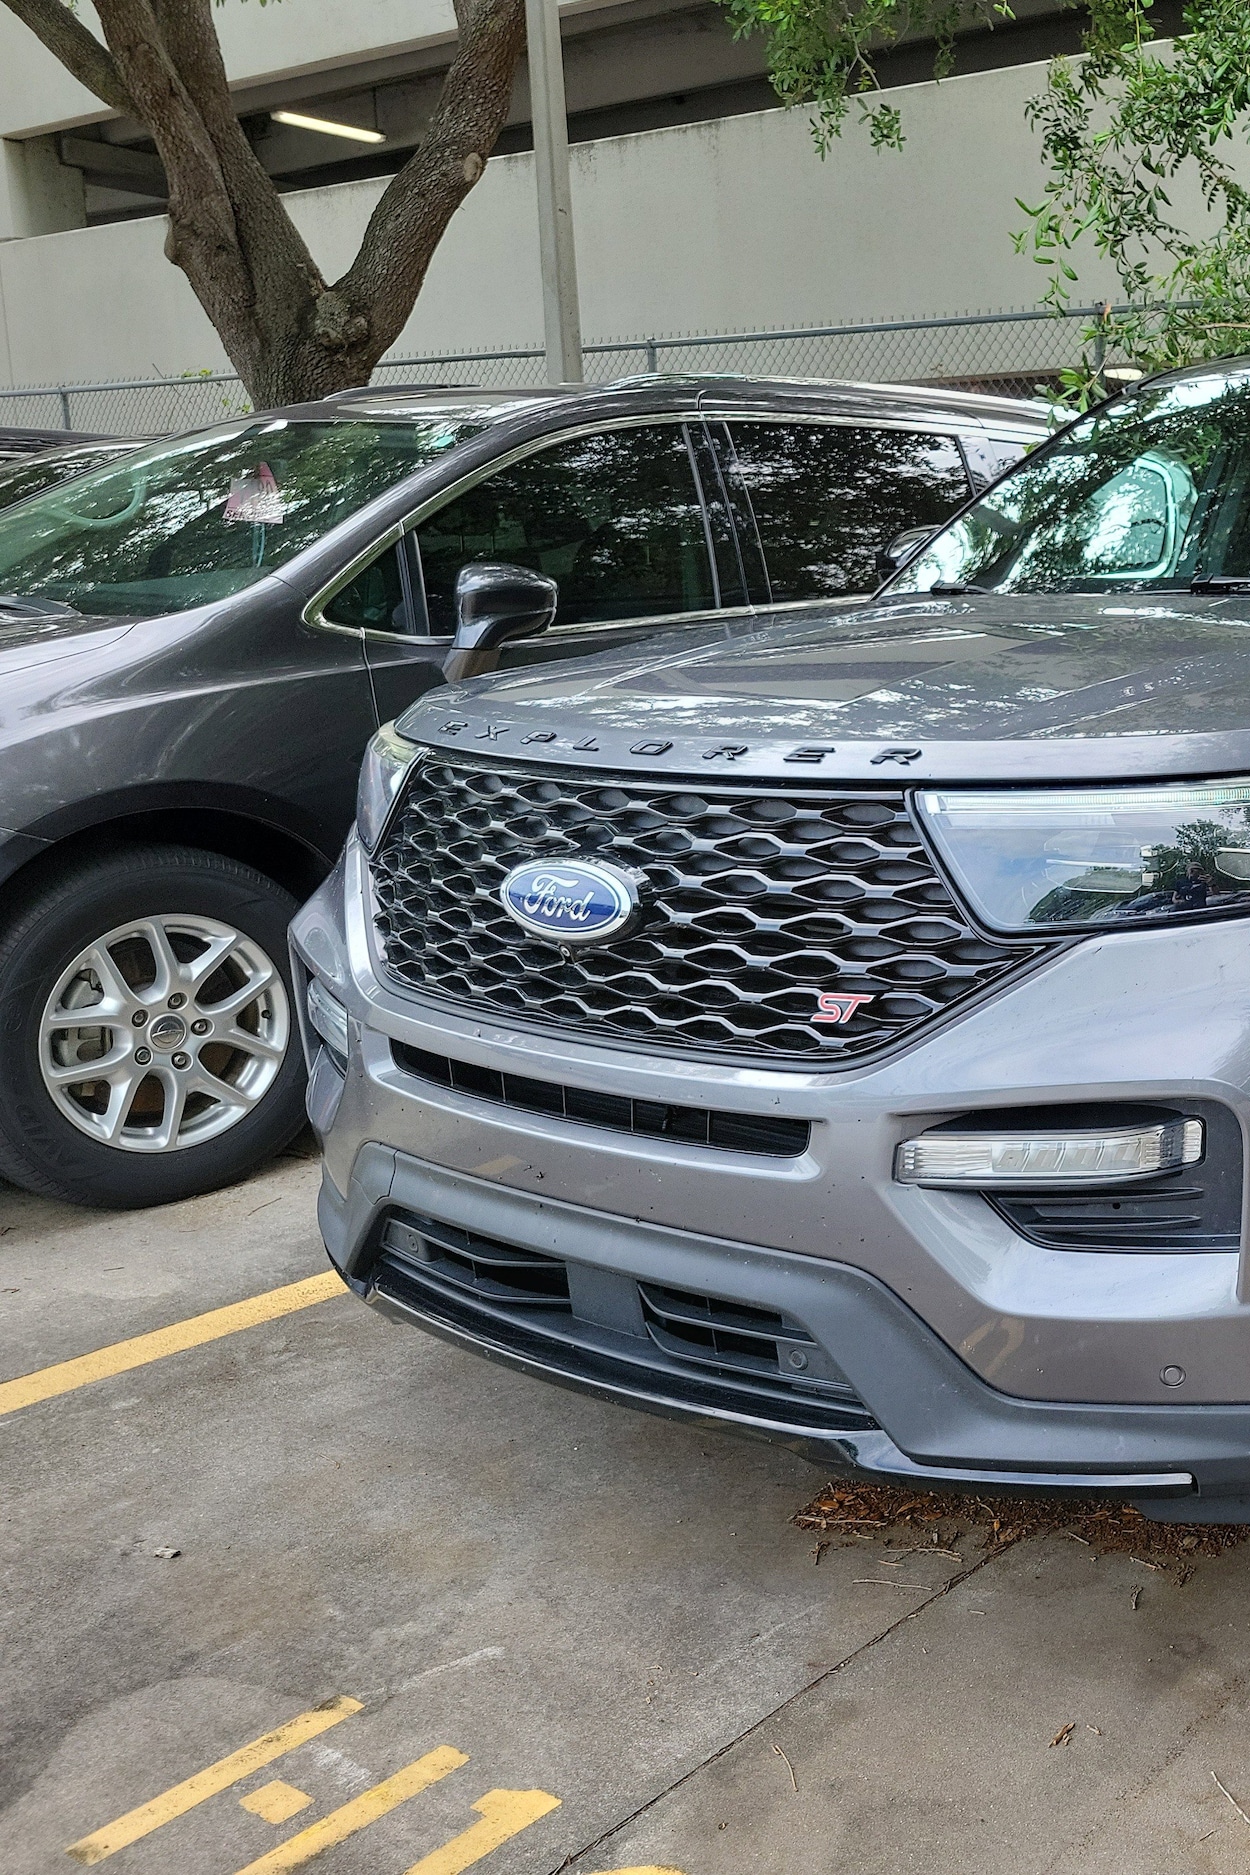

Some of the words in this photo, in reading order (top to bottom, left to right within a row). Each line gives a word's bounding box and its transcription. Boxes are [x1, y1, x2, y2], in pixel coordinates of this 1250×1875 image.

[438, 719, 923, 766] EXPLORER
[521, 873, 595, 922] Ford
[809, 992, 877, 1024] ST
